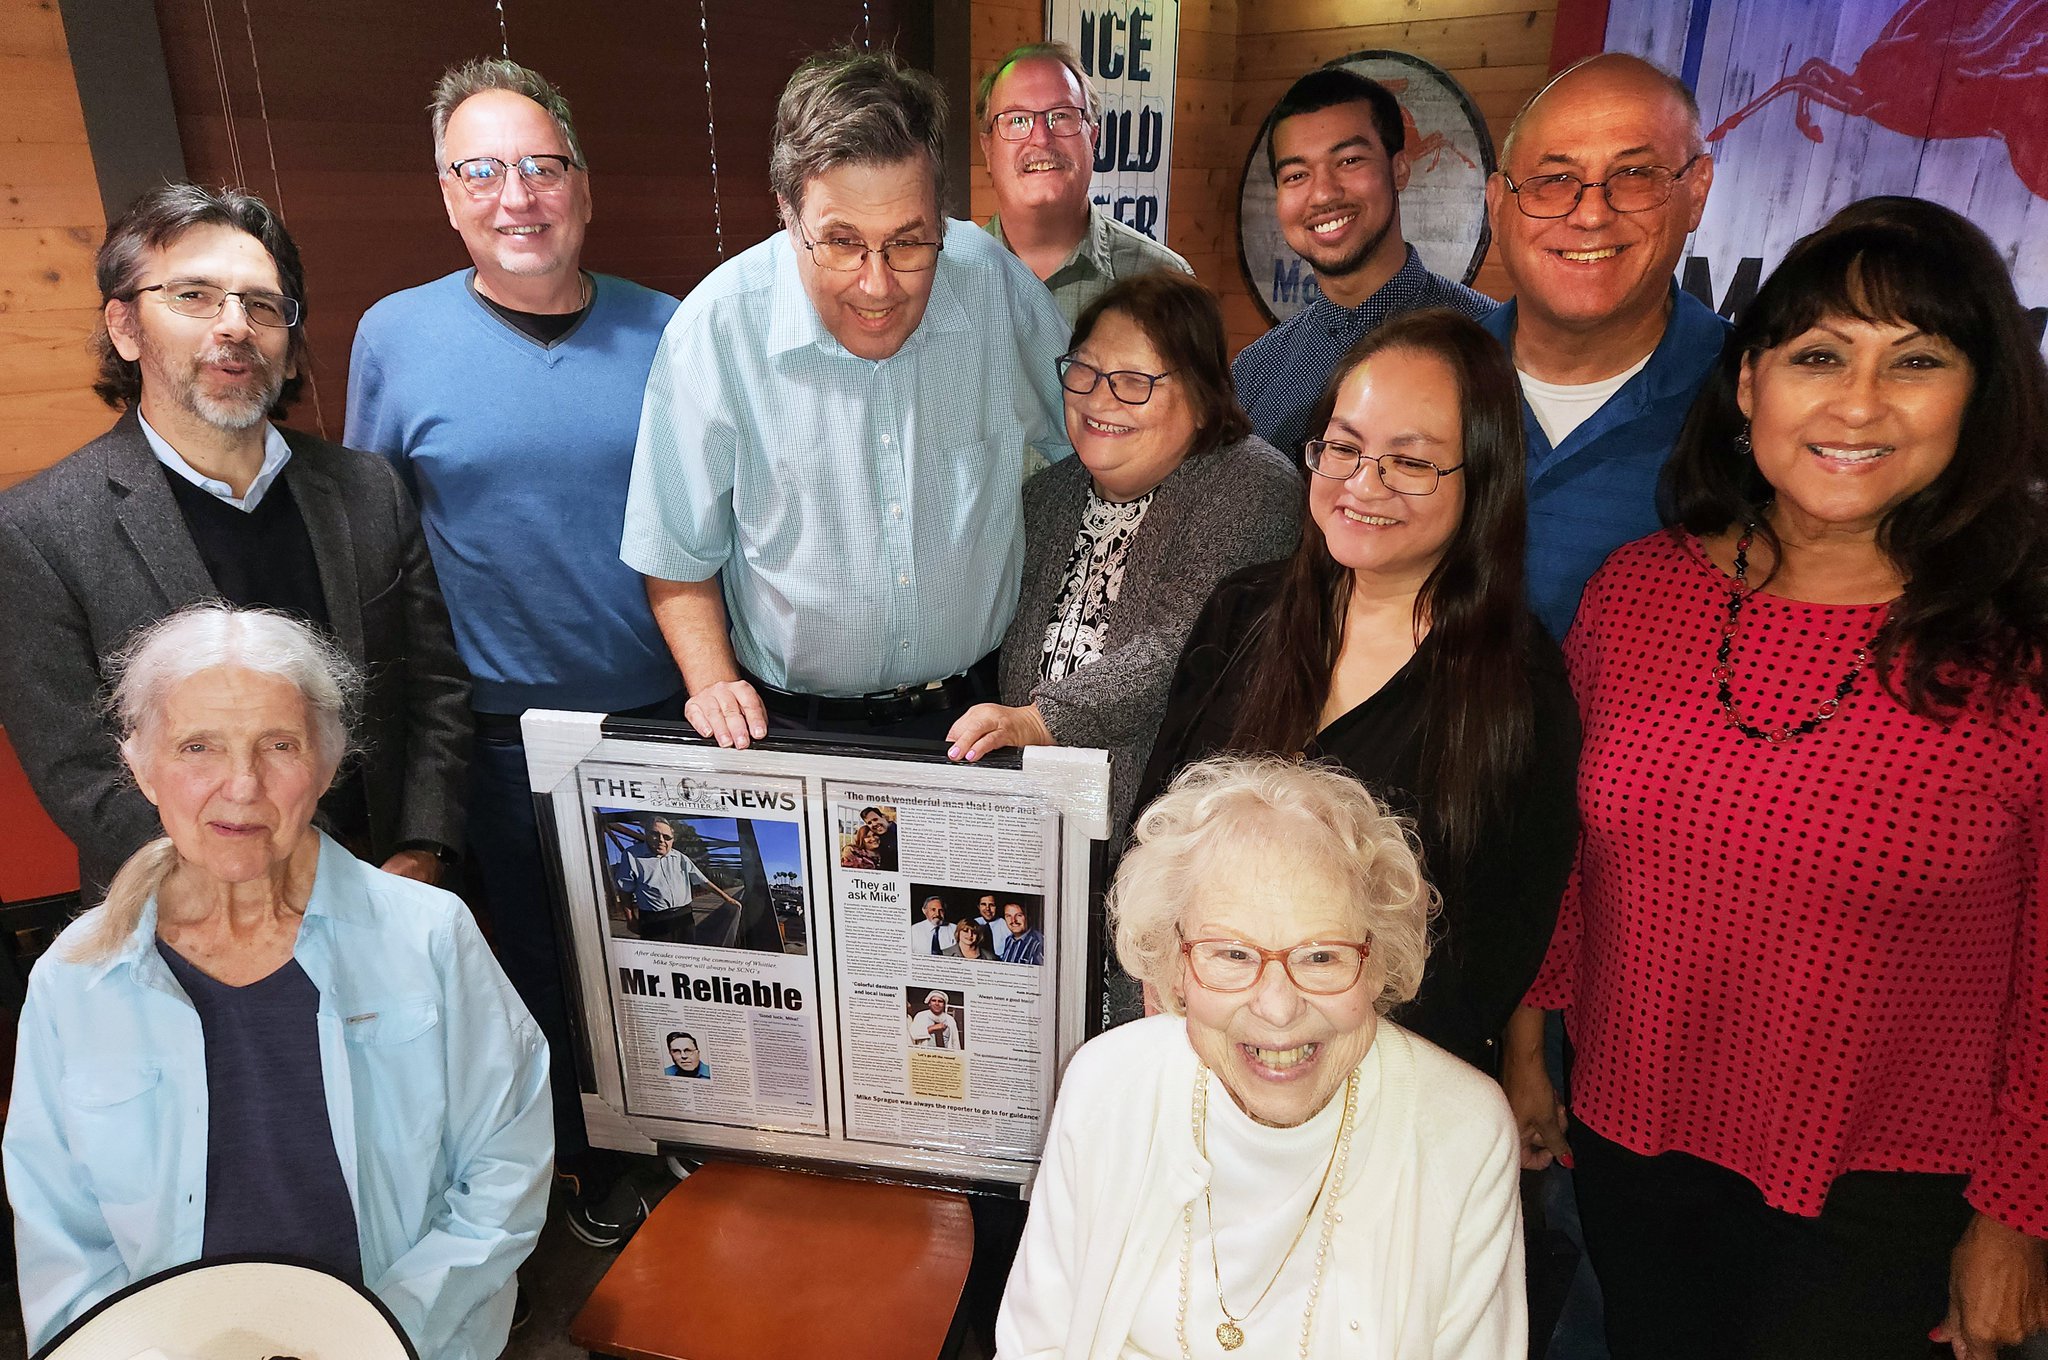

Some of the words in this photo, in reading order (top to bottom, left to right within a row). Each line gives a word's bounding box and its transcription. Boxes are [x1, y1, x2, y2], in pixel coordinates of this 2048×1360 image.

[1081, 7, 1153, 81] ICE
[1273, 258, 1319, 304] Mo
[588, 777, 645, 799] THE
[720, 788, 796, 811] NEWS
[670, 800, 711, 809] WHITTIER
[866, 794, 890, 803] most
[892, 796, 940, 807] wonderful
[966, 801, 986, 811] that
[994, 804, 1015, 813] ever
[851, 878, 879, 892] 'They
[882, 881, 895, 891] all
[848, 891, 867, 901] ask
[870, 891, 899, 903] Mike'
[712, 957, 744, 965] community
[619, 967, 666, 998] Mr.
[671, 972, 803, 1011] Reliable
[873, 1096, 899, 1104] Sprague
[913, 1100, 934, 1108] always
[947, 1104, 973, 1113] reporter
